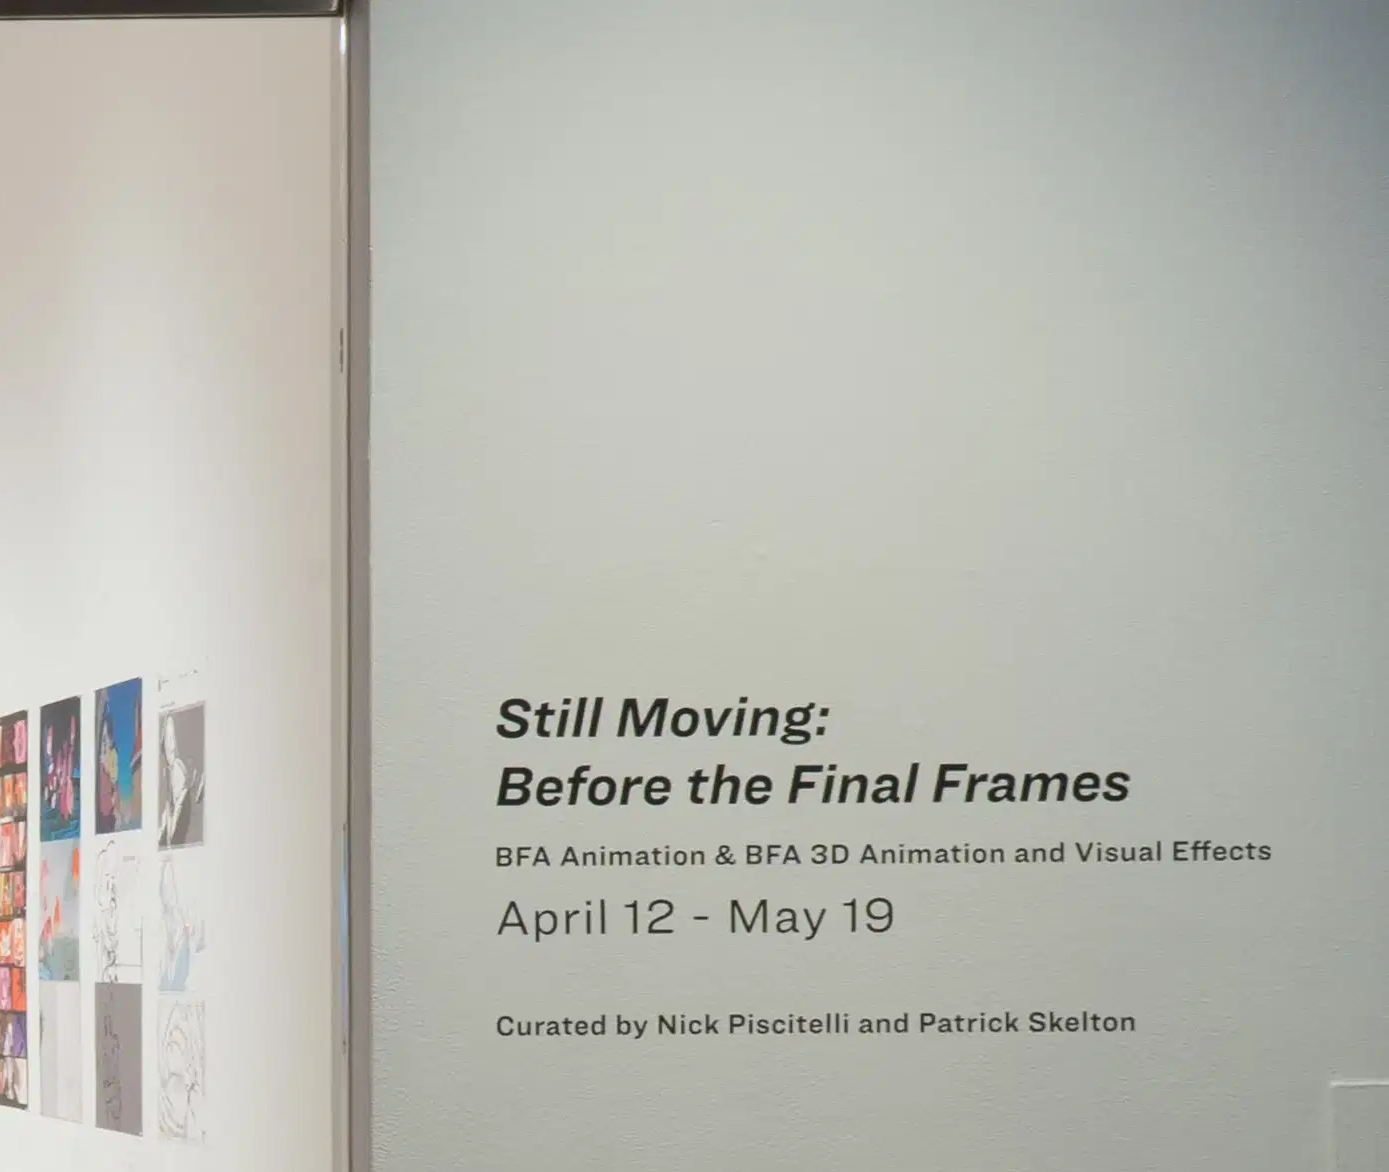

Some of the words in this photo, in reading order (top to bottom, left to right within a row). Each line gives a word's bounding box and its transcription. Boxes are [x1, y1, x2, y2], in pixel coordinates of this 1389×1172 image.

[495, 696, 604, 740] Still
[615, 695, 831, 746] Moving:
[495, 764, 672, 807] Before
[686, 763, 774, 806] the
[787, 762, 920, 805] Final
[932, 762, 1132, 804] Frames
[495, 845, 551, 868] BFA
[559, 844, 706, 867] Animation
[714, 844, 737, 866] &
[745, 844, 802, 865] BFA
[810, 843, 850, 865] 3D
[859, 842, 1006, 865] Animation
[1014, 841, 1065, 864] and
[1074, 840, 1162, 863] Visual
[1172, 839, 1272, 862] Effects
[496, 898, 607, 943] April
[624, 898, 675, 935] 12
[730, 898, 827, 941] May
[842, 896, 894, 934] 19
[496, 1013, 607, 1037] Curated
[616, 1014, 649, 1042] by
[657, 1013, 720, 1036] Nick
[728, 1012, 849, 1035] Piscitelli
[858, 1012, 909, 1034] and
[919, 1011, 1019, 1034] Patrick
[1028, 1010, 1136, 1033] Skelton
